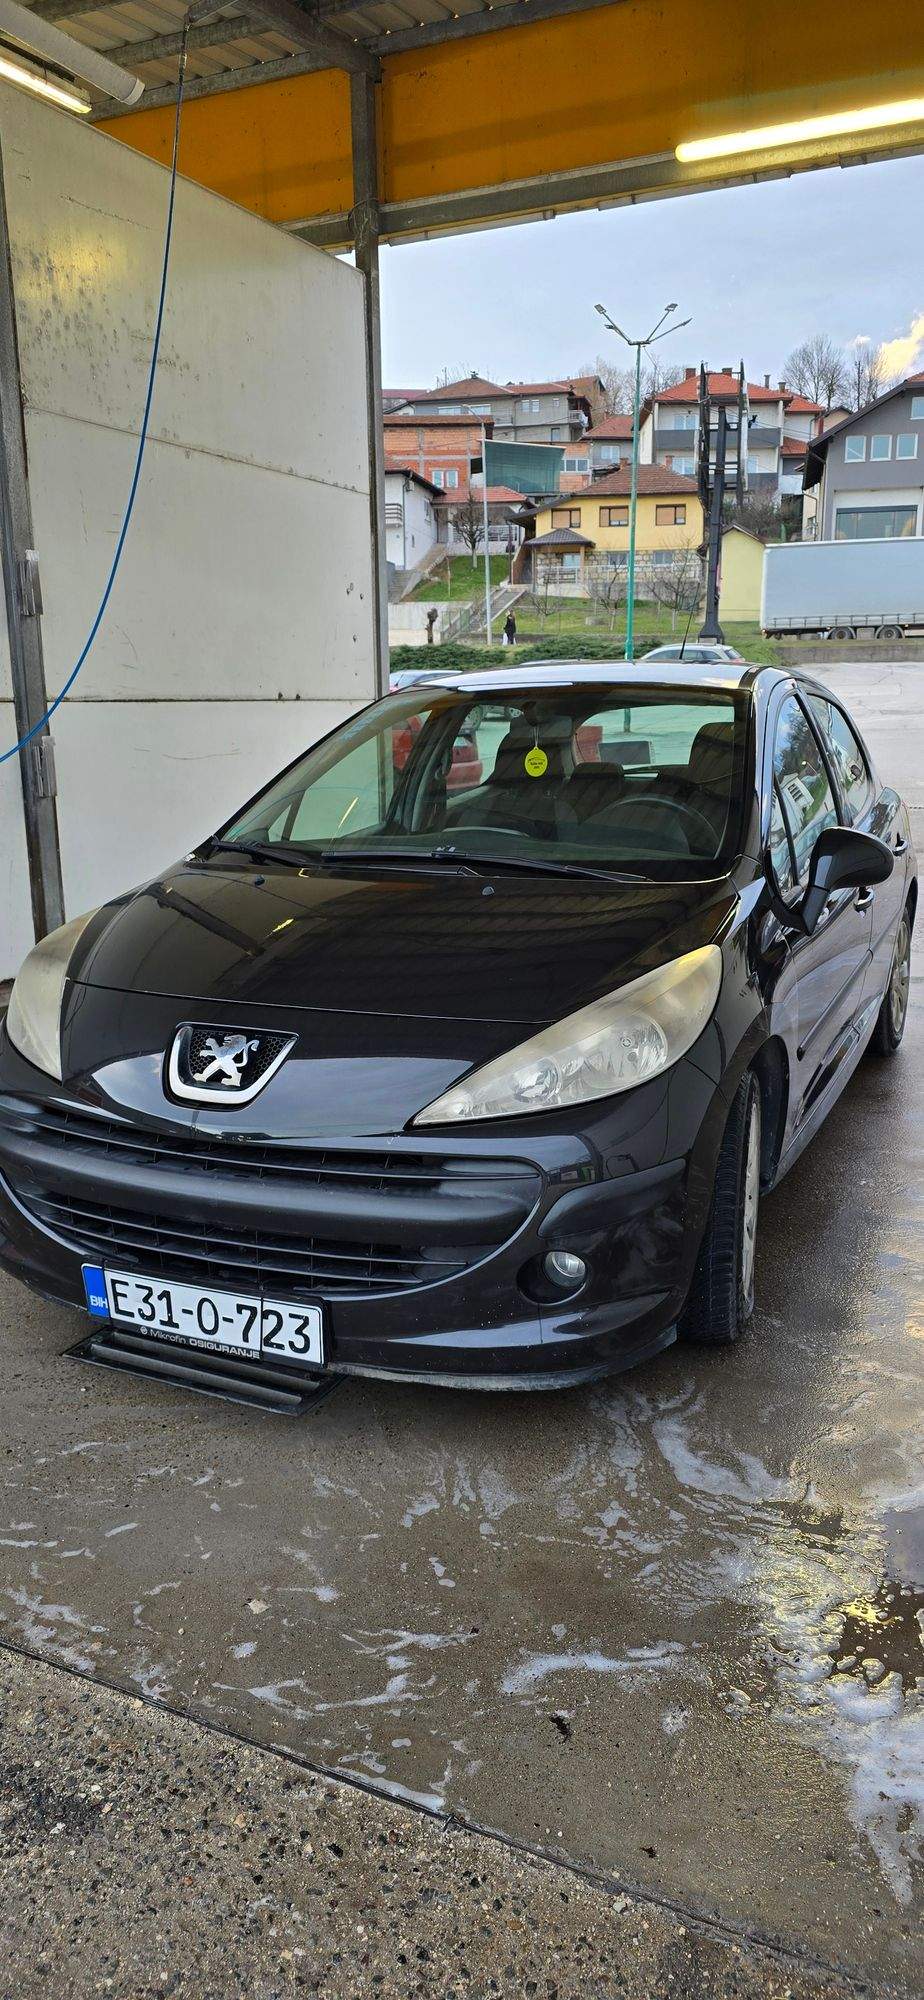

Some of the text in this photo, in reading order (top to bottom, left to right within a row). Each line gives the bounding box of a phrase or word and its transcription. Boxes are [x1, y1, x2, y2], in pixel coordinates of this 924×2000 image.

[90, 1294, 109, 1309] BIH
[149, 1329, 262, 1359] Mikrofin OSIGURANJE
